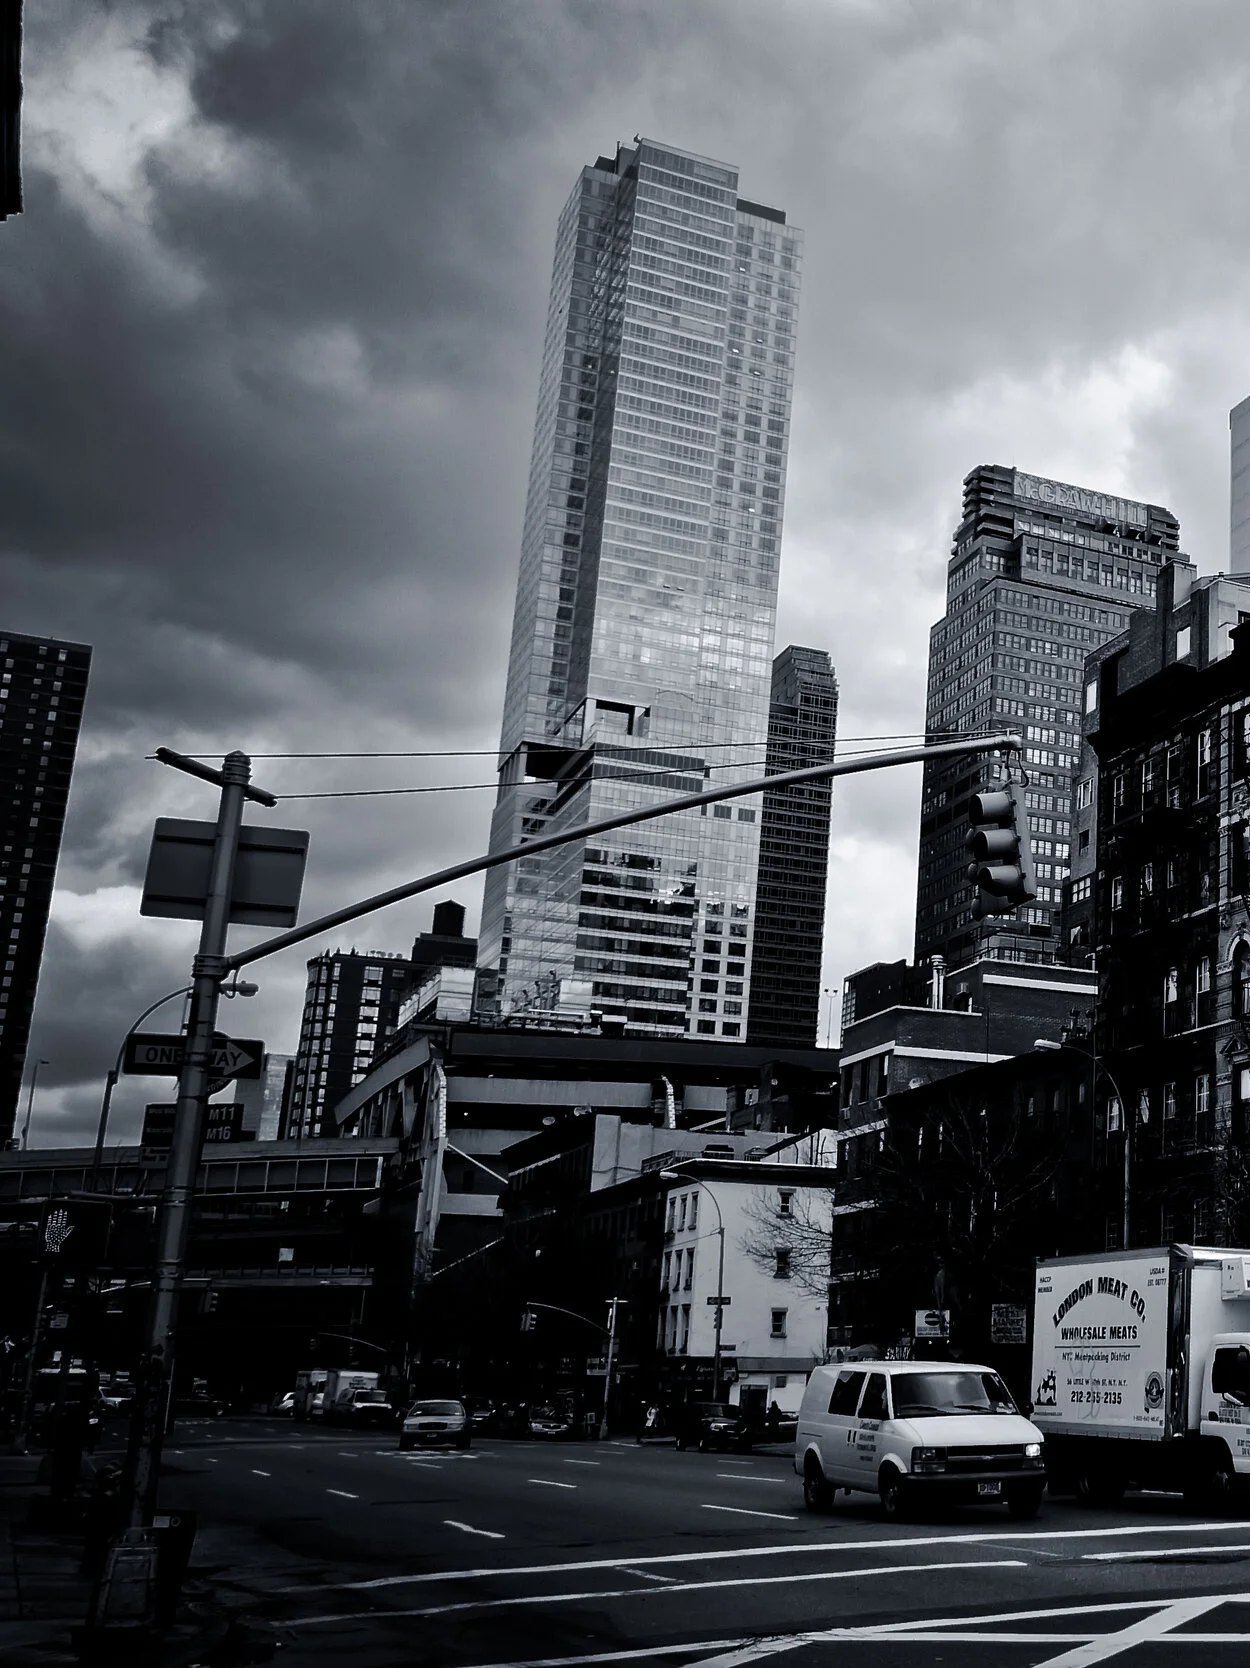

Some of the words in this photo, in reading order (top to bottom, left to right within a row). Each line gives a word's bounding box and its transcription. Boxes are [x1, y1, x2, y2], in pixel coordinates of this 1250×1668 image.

[146, 1048, 185, 1064] ONE
[208, 1107, 236, 1121] M11
[205, 1125, 232, 1141] M16
[1052, 1278, 1094, 1328] LONDON
[1097, 1276, 1128, 1301] MEAT
[1130, 1289, 1146, 1323] CO.
[1061, 1326, 1107, 1340] WHOLESALE
[1109, 1325, 1138, 1340] MEATS
[1074, 1351, 1109, 1363] Meatpacking
[1110, 1351, 1131, 1361] District
